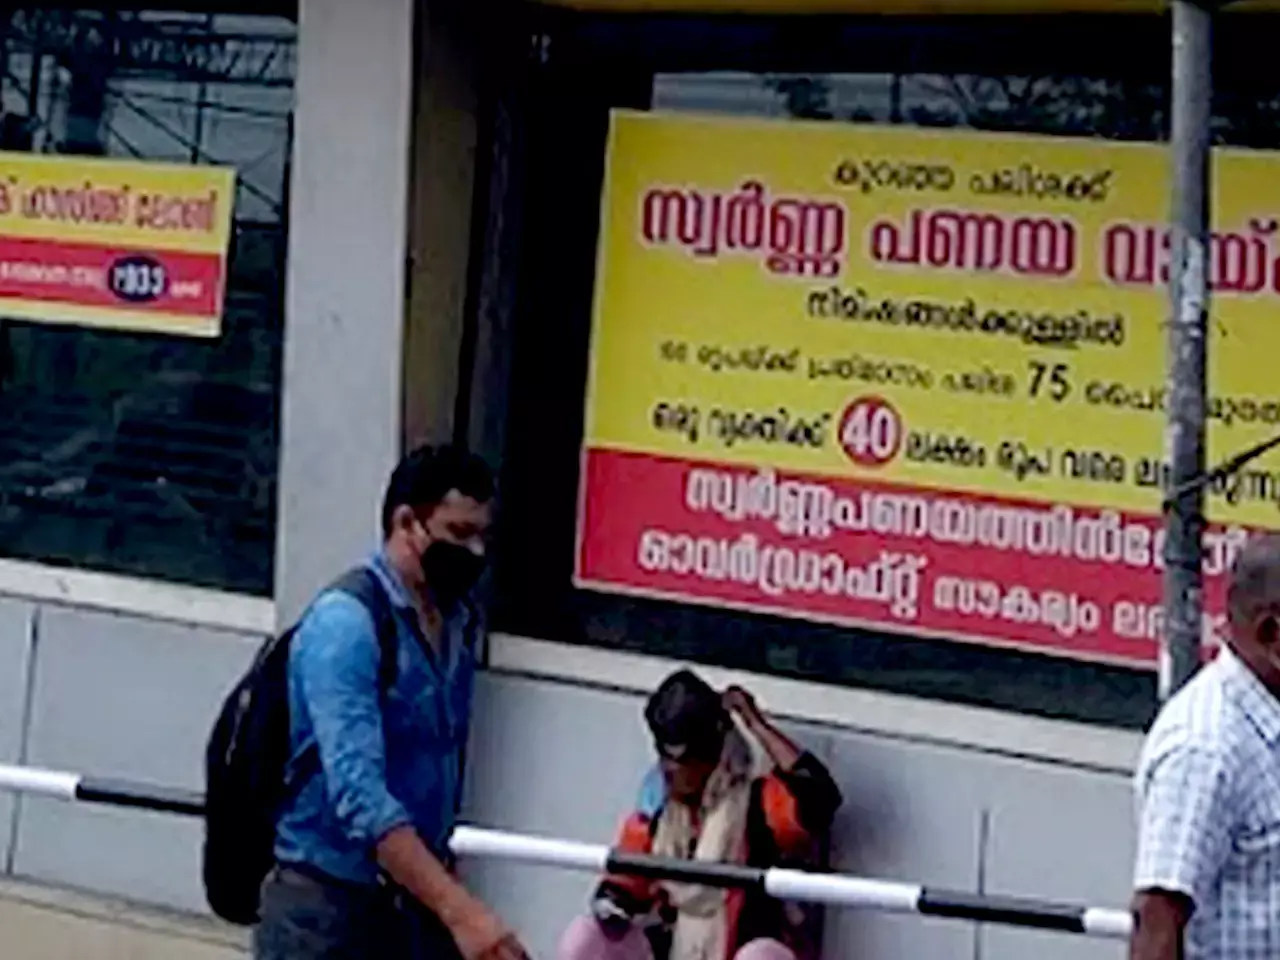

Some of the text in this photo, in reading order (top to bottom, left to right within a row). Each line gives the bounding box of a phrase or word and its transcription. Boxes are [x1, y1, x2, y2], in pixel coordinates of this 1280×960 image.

[870, 209, 1076, 276] പണയ
[1027, 360, 1071, 402] 75
[843, 403, 899, 459] 40
